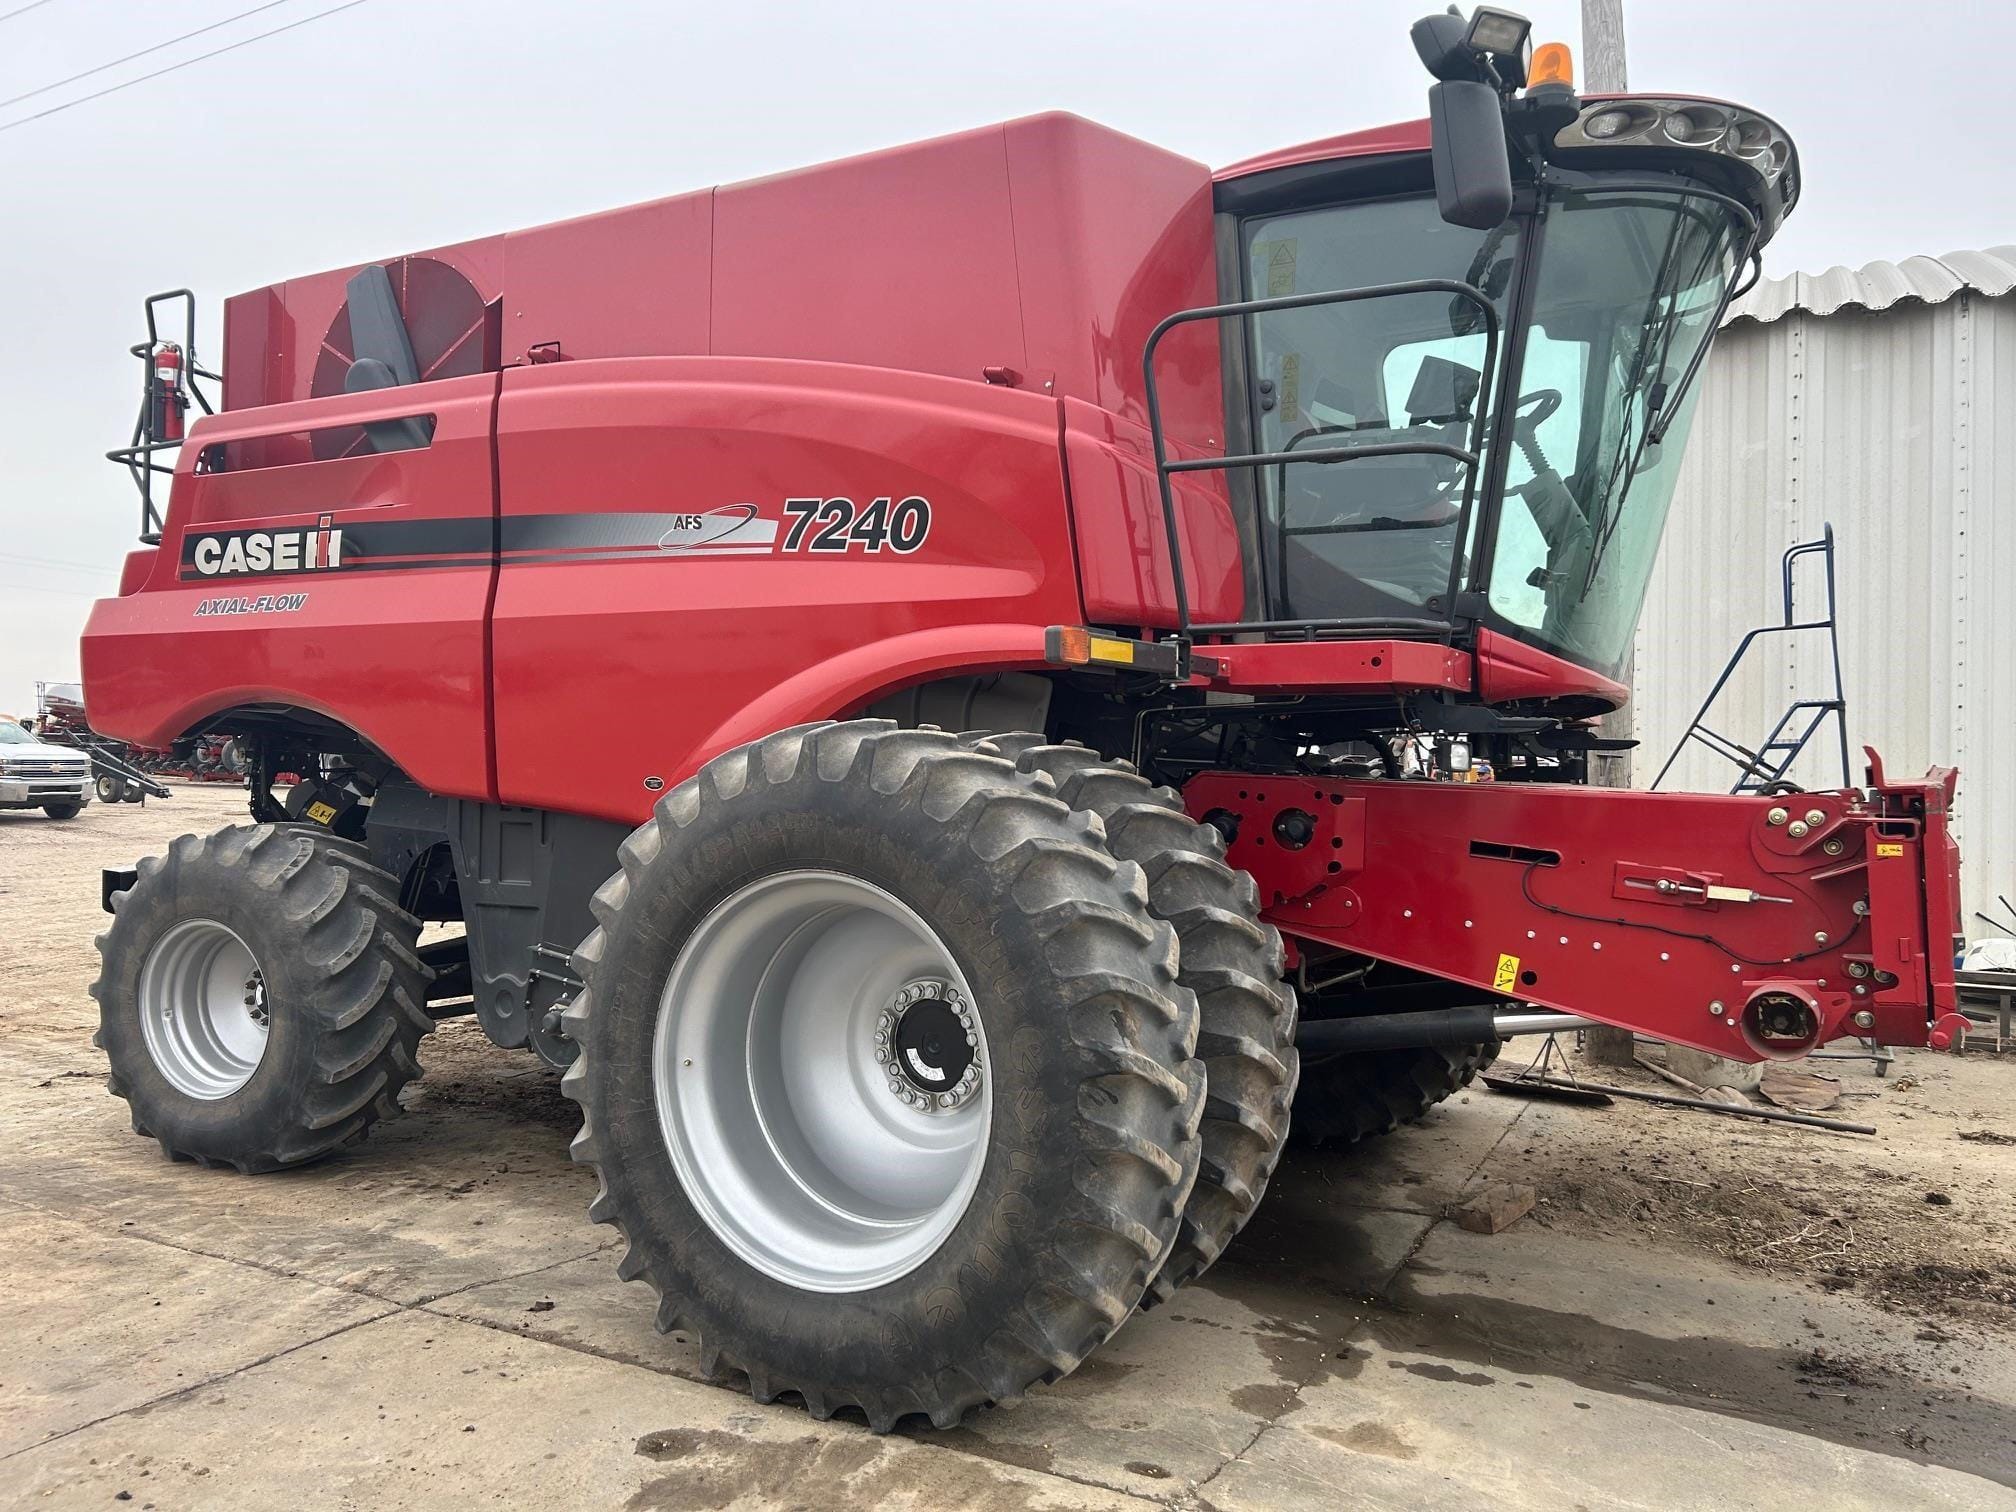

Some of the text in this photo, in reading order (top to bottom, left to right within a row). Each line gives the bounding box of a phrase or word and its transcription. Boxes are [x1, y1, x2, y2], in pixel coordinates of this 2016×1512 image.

[673, 514, 702, 530] AFS
[783, 496, 931, 554] 7240
[195, 533, 300, 575] CASE
[193, 593, 308, 616] AXIAL-FLOW
